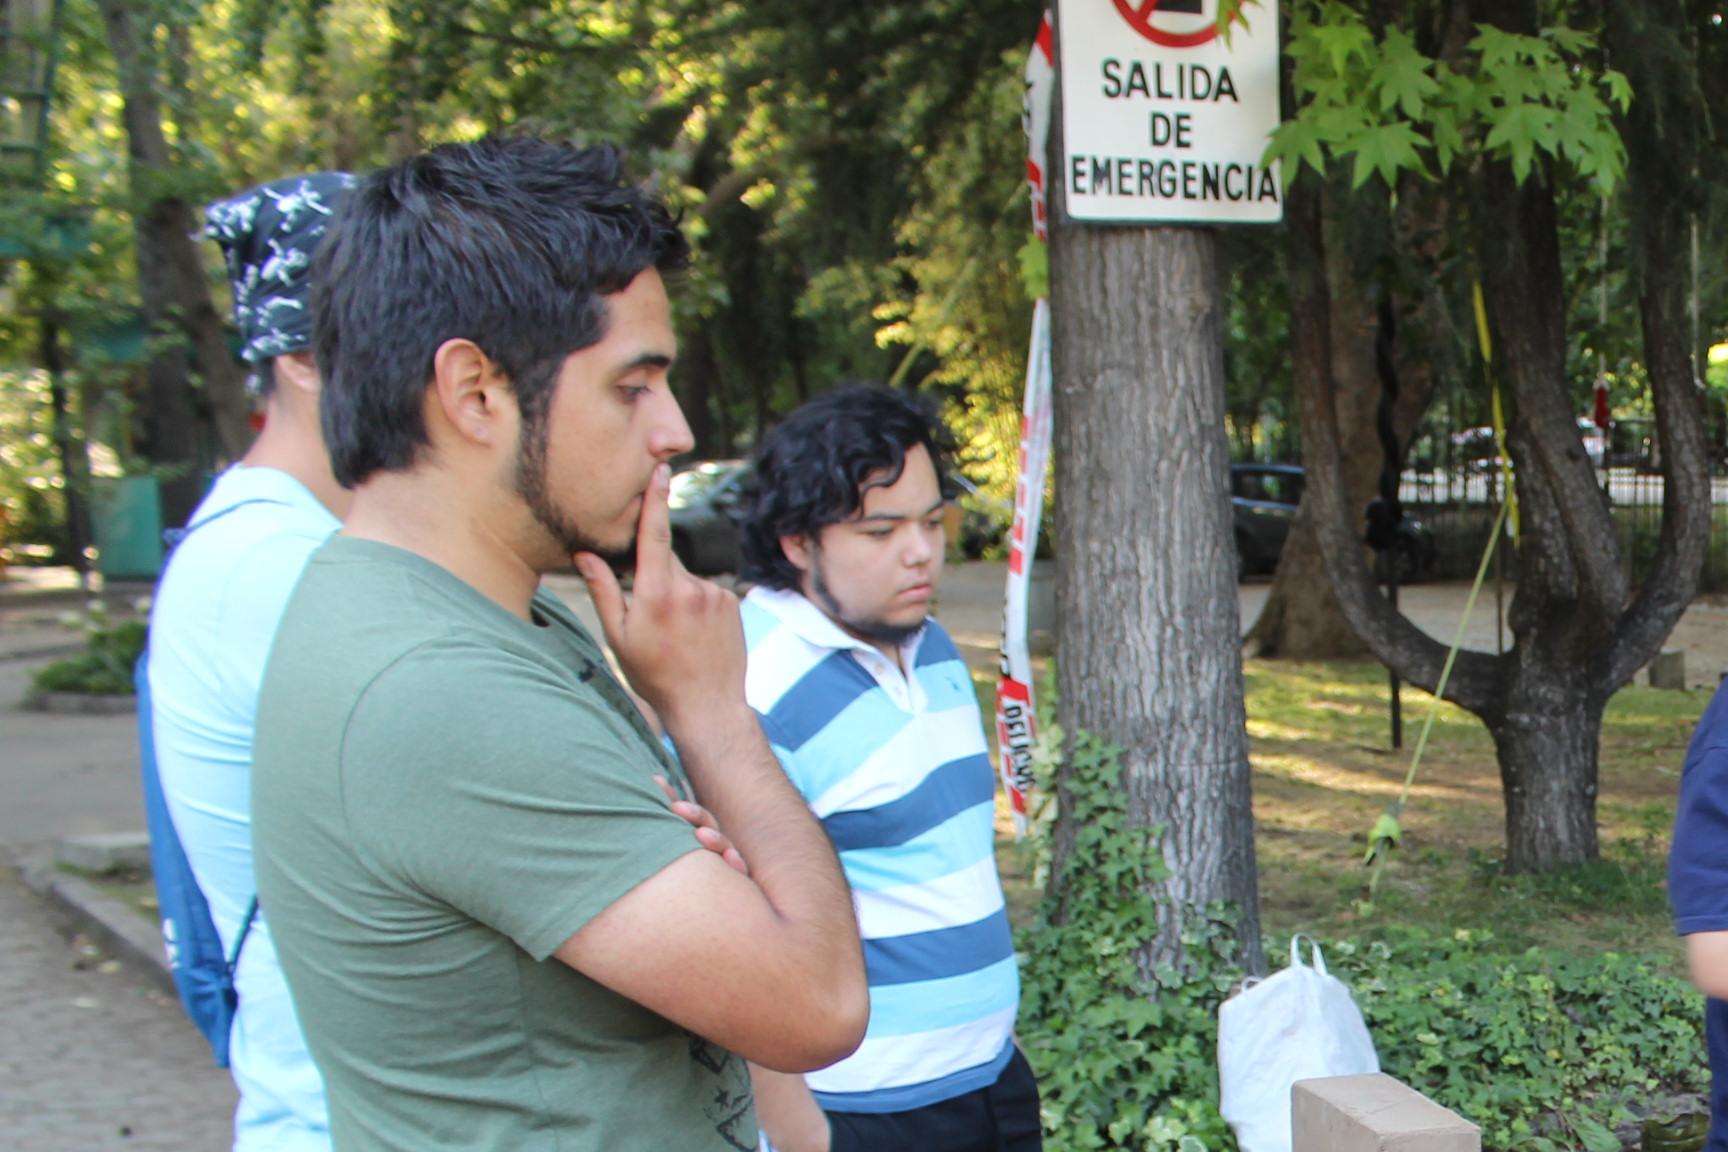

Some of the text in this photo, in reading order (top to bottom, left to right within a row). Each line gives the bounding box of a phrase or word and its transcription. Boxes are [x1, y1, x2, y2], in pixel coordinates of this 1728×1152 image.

[1101, 57, 1239, 102] SALIDA
[1150, 110, 1192, 148] DE
[1070, 154, 1278, 203] EMERGENCIA
